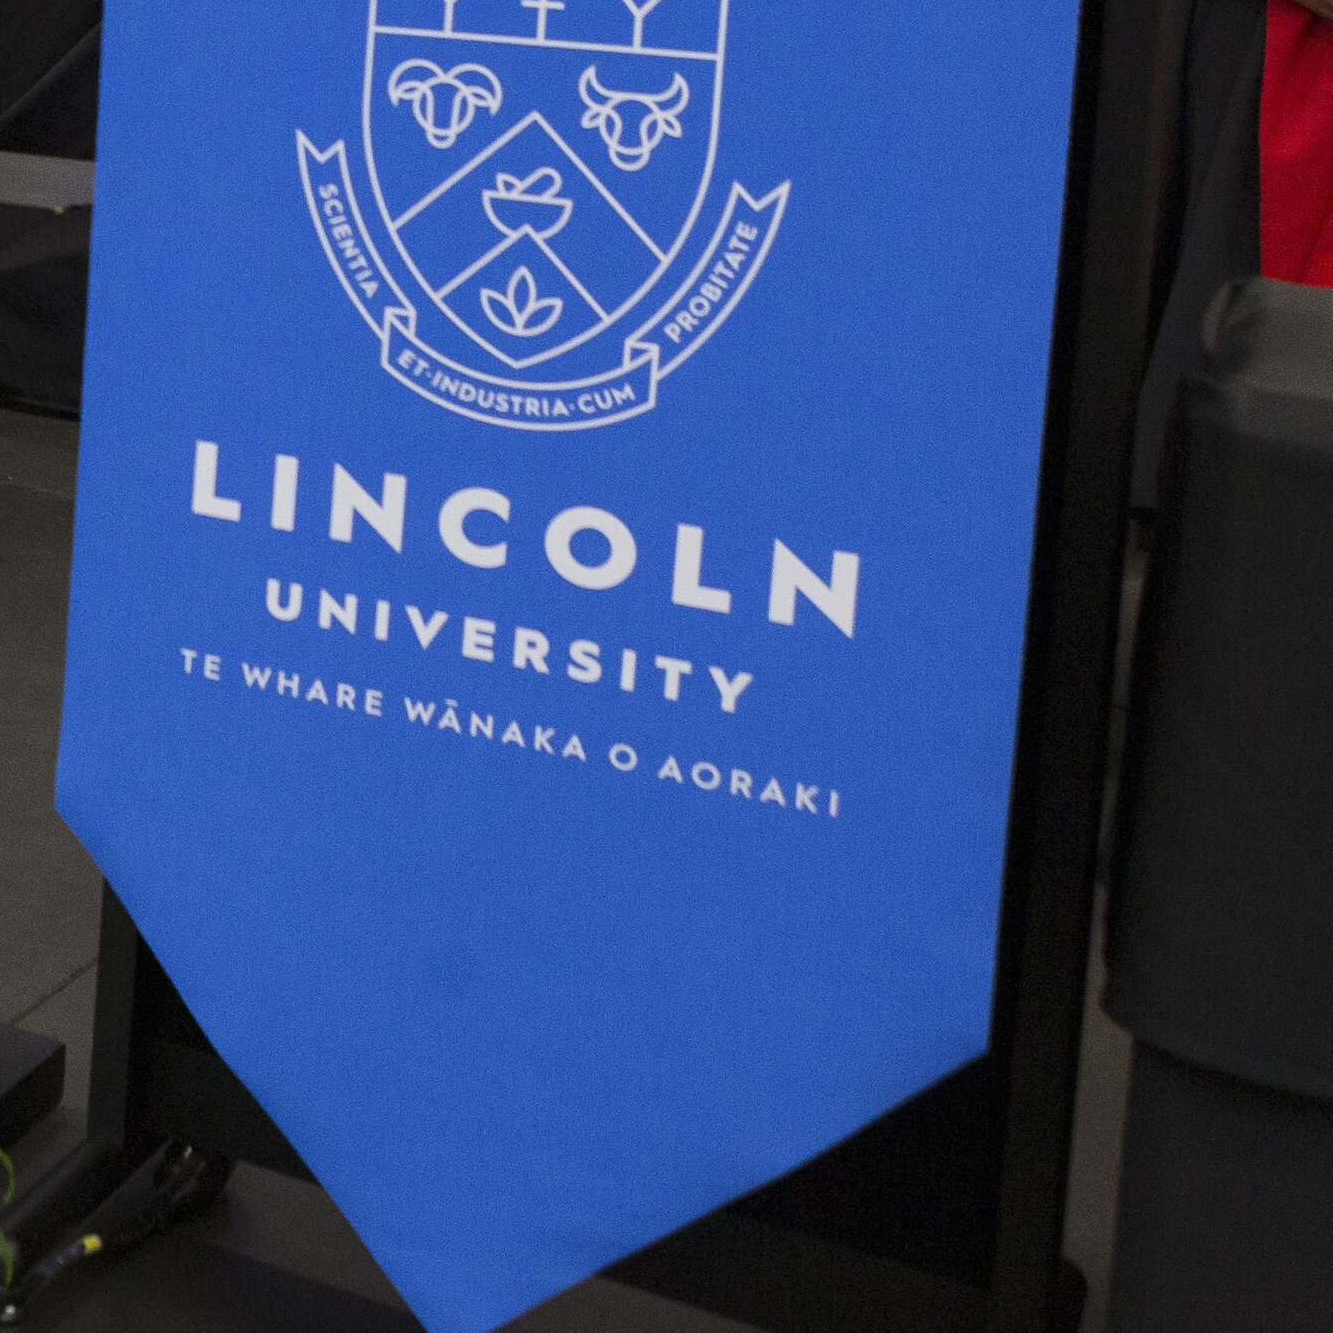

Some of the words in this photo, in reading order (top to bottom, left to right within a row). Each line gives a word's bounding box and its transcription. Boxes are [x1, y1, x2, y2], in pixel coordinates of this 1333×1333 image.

[317, 182, 380, 299] SCIENTIA
[663, 221, 759, 345] PROBITATE
[190, 439, 861, 639] LINCOLN
[264, 576, 753, 714] UNIVERSITY
[180, 647, 221, 681] TE
[241, 662, 384, 718] WHARE
[403, 696, 587, 762] WĀNAKA
[609, 742, 639, 773] O
[657, 755, 841, 819] AORAKI
